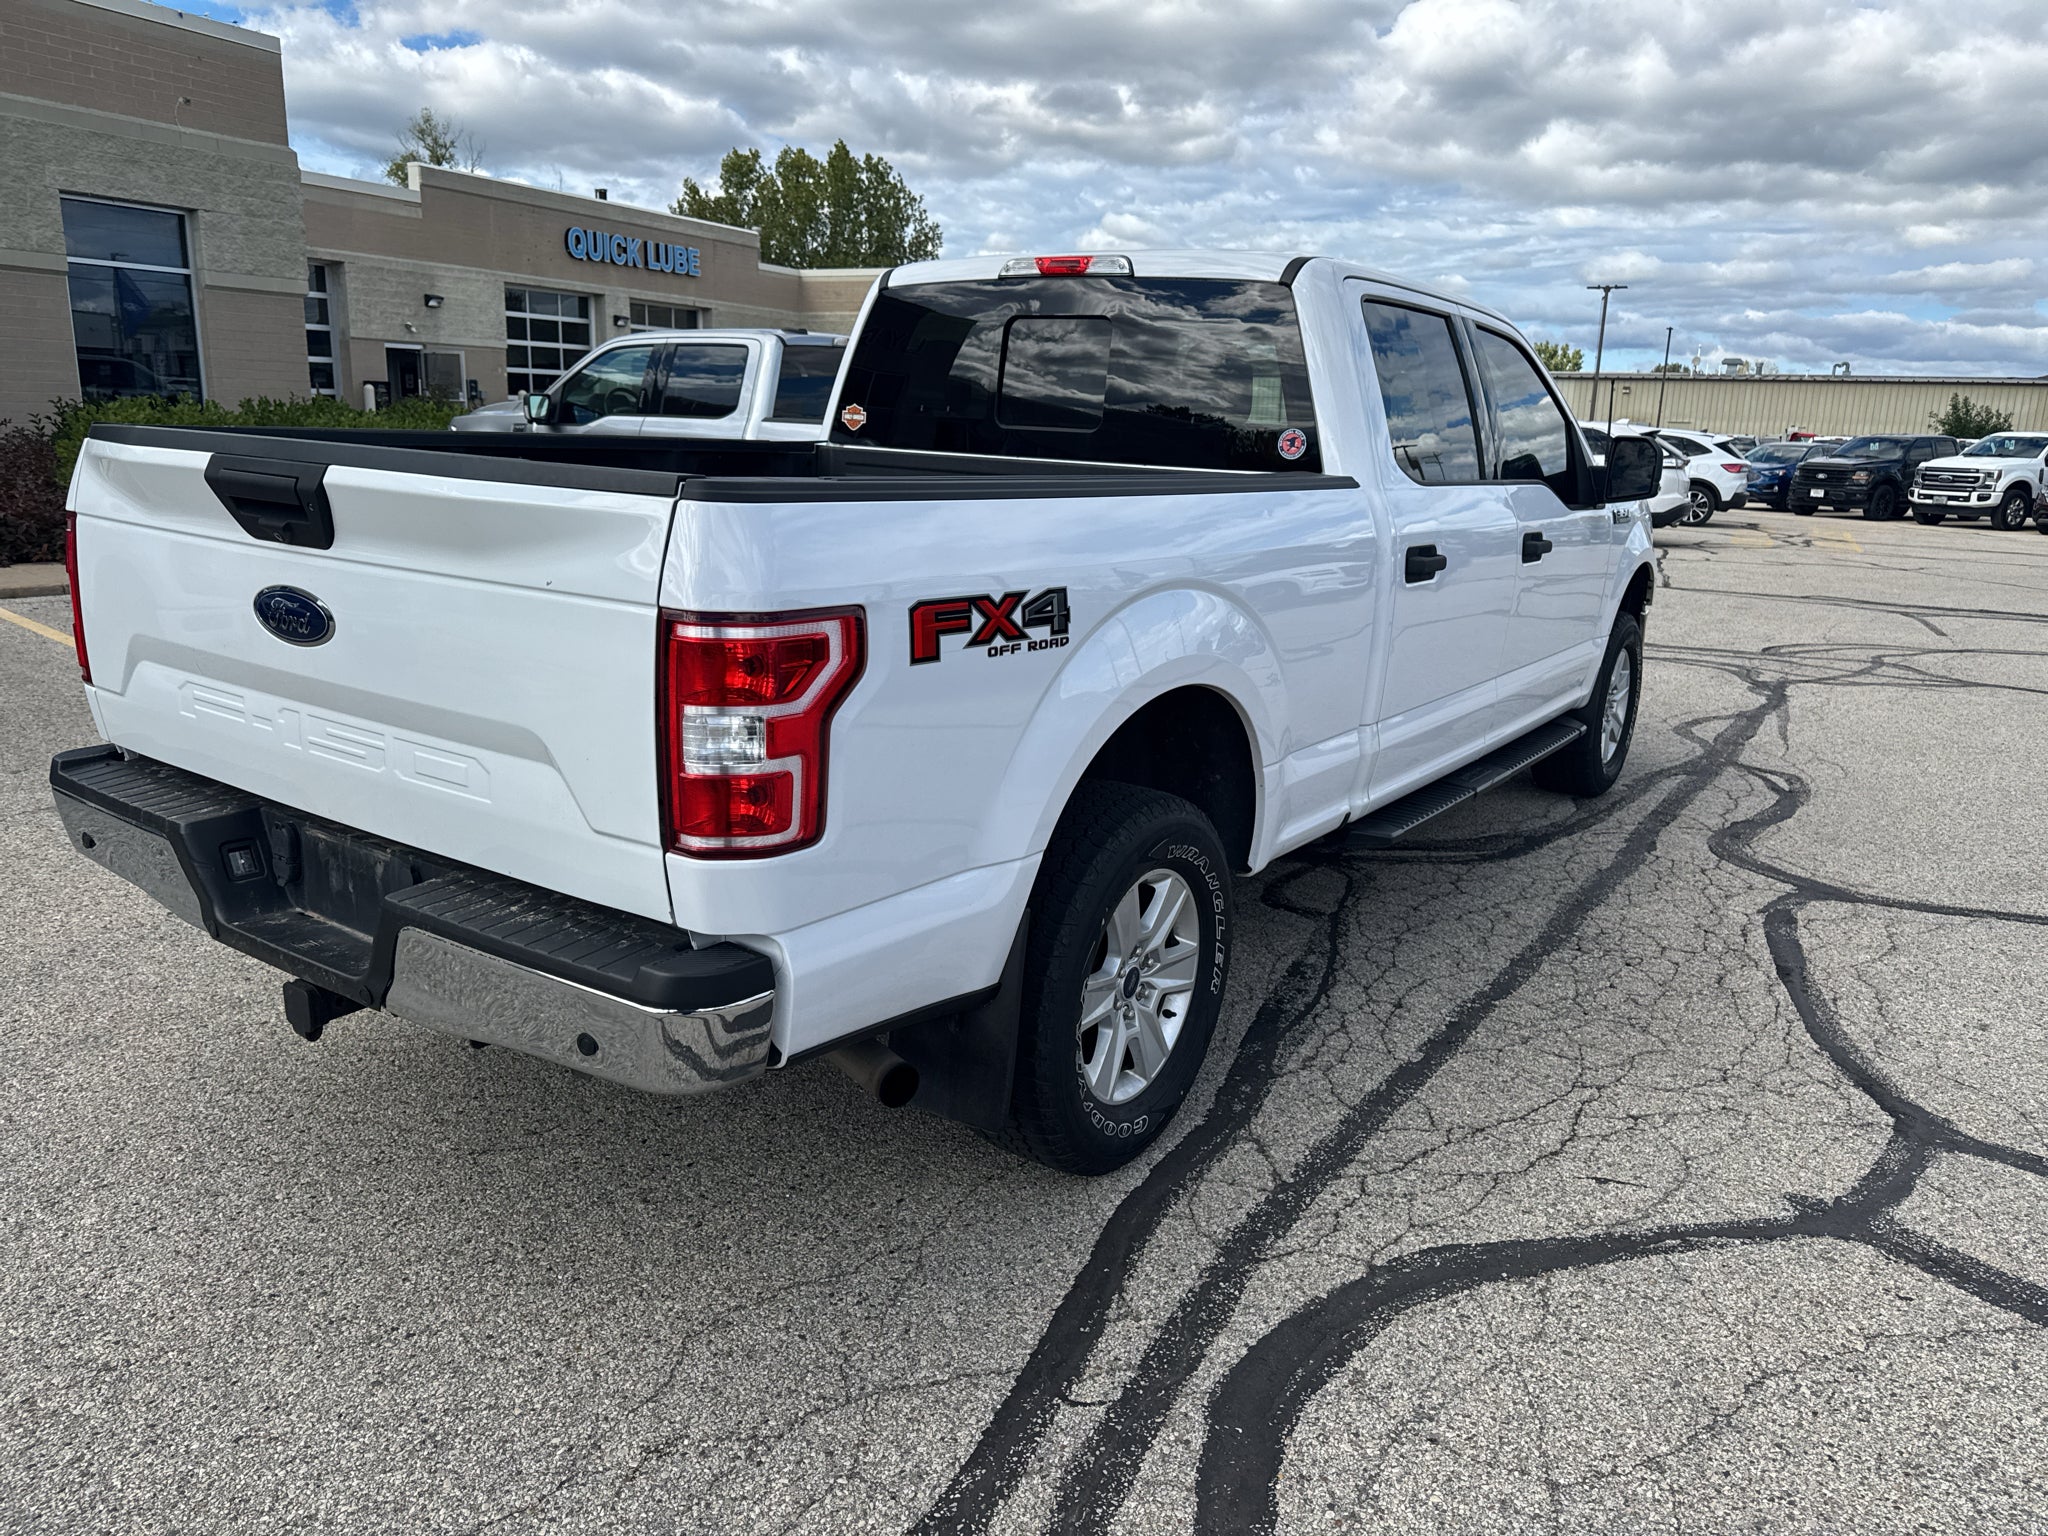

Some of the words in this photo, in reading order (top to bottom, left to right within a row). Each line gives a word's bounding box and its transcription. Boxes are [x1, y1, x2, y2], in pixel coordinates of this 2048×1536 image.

[566, 226, 642, 268] QUICK
[646, 240, 701, 277] LUBE
[267, 597, 311, 634] Ford
[908, 586, 1071, 666] FX4
[987, 643, 1022, 658] OFF
[1028, 636, 1070, 652] ROAD
[178, 680, 492, 803] F-150
[1167, 844, 1226, 995] WRANGLER
